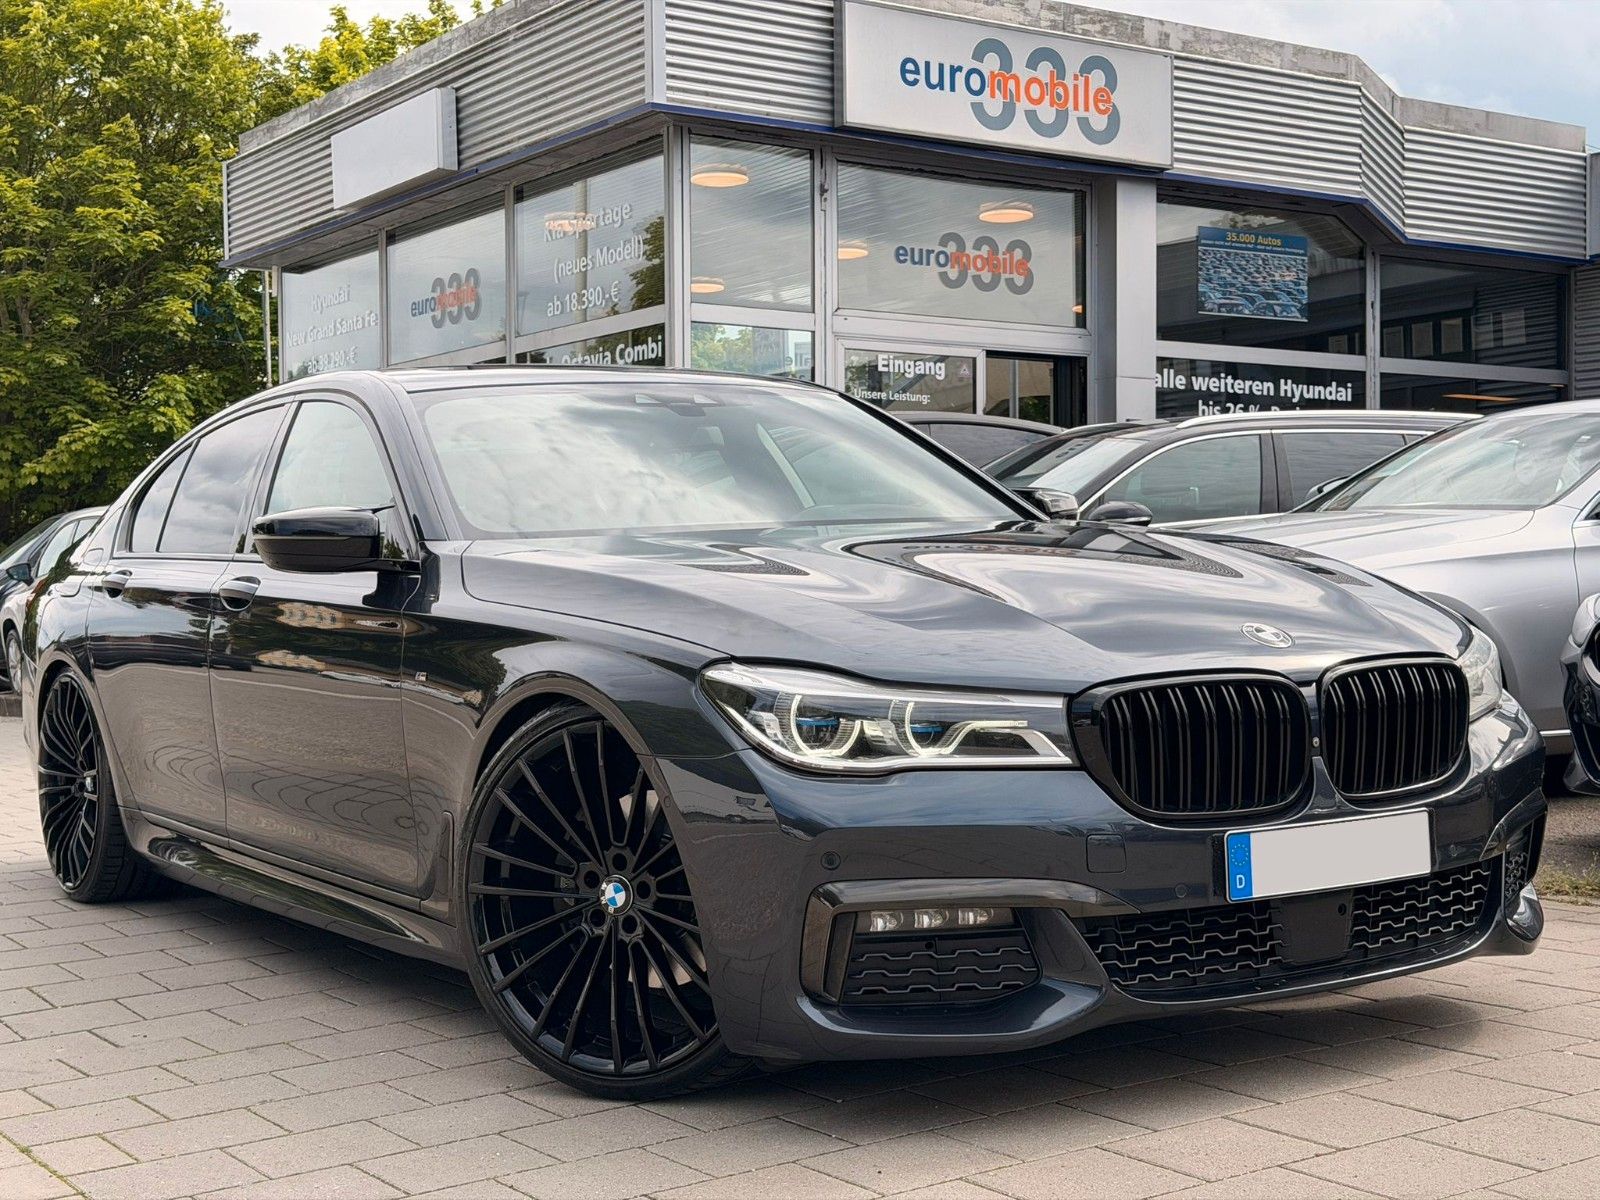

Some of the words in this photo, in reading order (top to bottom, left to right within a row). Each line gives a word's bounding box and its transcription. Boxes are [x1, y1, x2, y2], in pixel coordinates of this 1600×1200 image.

[899, 56, 1114, 116] euromobile
[970, 37, 1121, 146] 333
[1225, 231, 1256, 243] 35.000
[1257, 235, 1282, 246] Autos
[553, 256, 593, 284] (neues
[596, 234, 644, 268] Modell)
[894, 245, 1030, 276] euromobile
[937, 232, 1034, 295] 333
[311, 284, 351, 314] Hyundai
[430, 268, 481, 329] 333
[547, 296, 561, 317] ab
[287, 331, 306, 348] New
[308, 320, 335, 342] Grand
[336, 314, 362, 336] Santa
[615, 335, 662, 365] Combi
[307, 356, 320, 375] ab
[877, 354, 946, 380] Eingang
[853, 388, 887, 400] Unsere
[889, 391, 931, 405] Leistung:
[1155, 368, 1186, 389] alle
[1191, 373, 1275, 396] weiteren
[1279, 378, 1353, 403] Hyundai
[1198, 399, 1222, 416] bis
[1236, 874, 1246, 888] D
